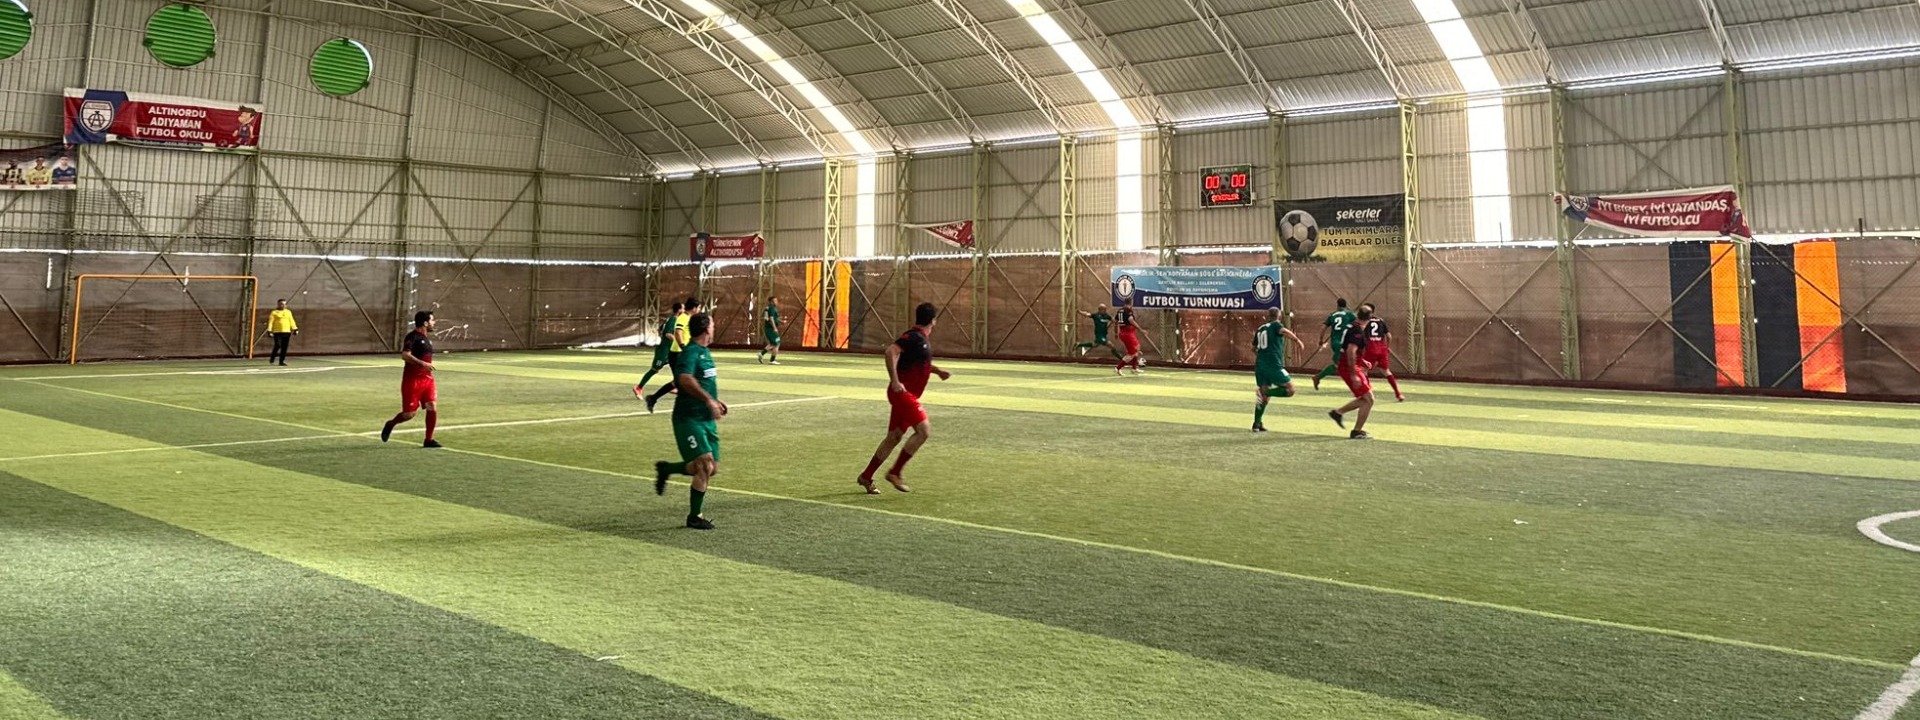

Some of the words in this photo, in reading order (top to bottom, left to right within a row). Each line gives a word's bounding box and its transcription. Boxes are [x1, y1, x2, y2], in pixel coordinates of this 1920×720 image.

[148, 105, 207, 118] ALTINORDU
[150, 116, 202, 129] ADIYAMAN
[136, 126, 177, 138] FUTBOL
[178, 129, 213, 140] OKULU
[1335, 207, 1382, 221] şekerler
[1650, 202, 1665, 213] İYİ
[1623, 213, 1640, 225] İYİ
[1640, 213, 1701, 226] FUTBOLCU
[1323, 225, 1342, 236] TÜM
[1345, 224, 1400, 235] TAKIMLARA
[1321, 238, 1373, 249] BAŞARILAR
[1142, 296, 1181, 306] FUTBOL
[1183, 297, 1245, 308] TURNUVASI
[1334, 316, 1343, 331] 2
[1370, 322, 1379, 336] 2
[1257, 330, 1268, 349] 10
[687, 435, 698, 449] 3
